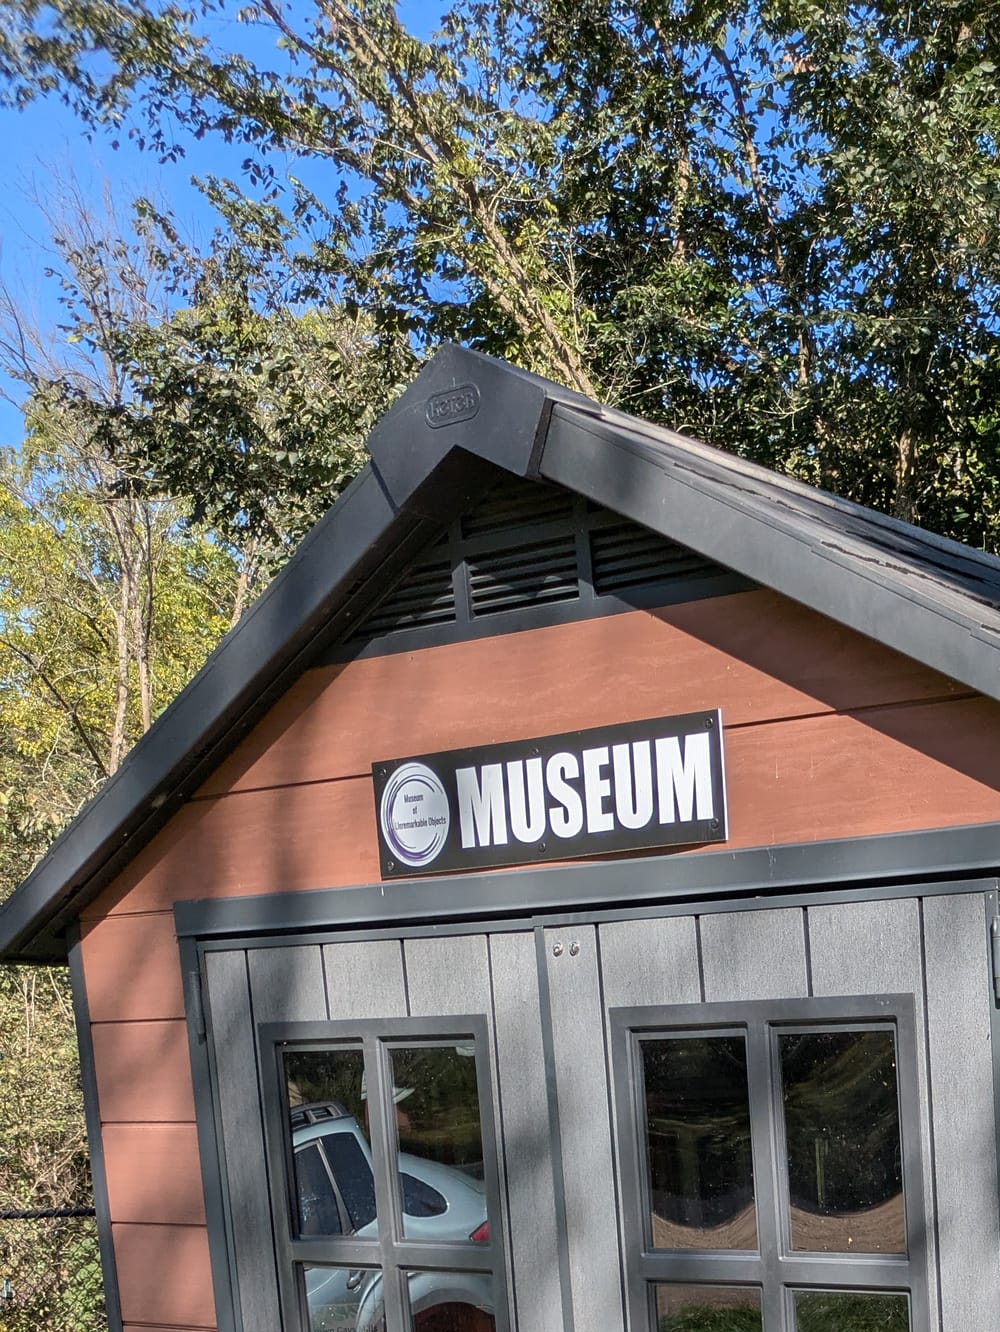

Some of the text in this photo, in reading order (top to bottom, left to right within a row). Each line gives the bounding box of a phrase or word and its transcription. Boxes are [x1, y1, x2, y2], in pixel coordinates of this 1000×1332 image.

[456, 732, 714, 849] MUSEUM
[404, 794, 424, 803] Museum
[412, 805, 418, 815] of
[395, 816, 446, 830] Unremarkable Objects
